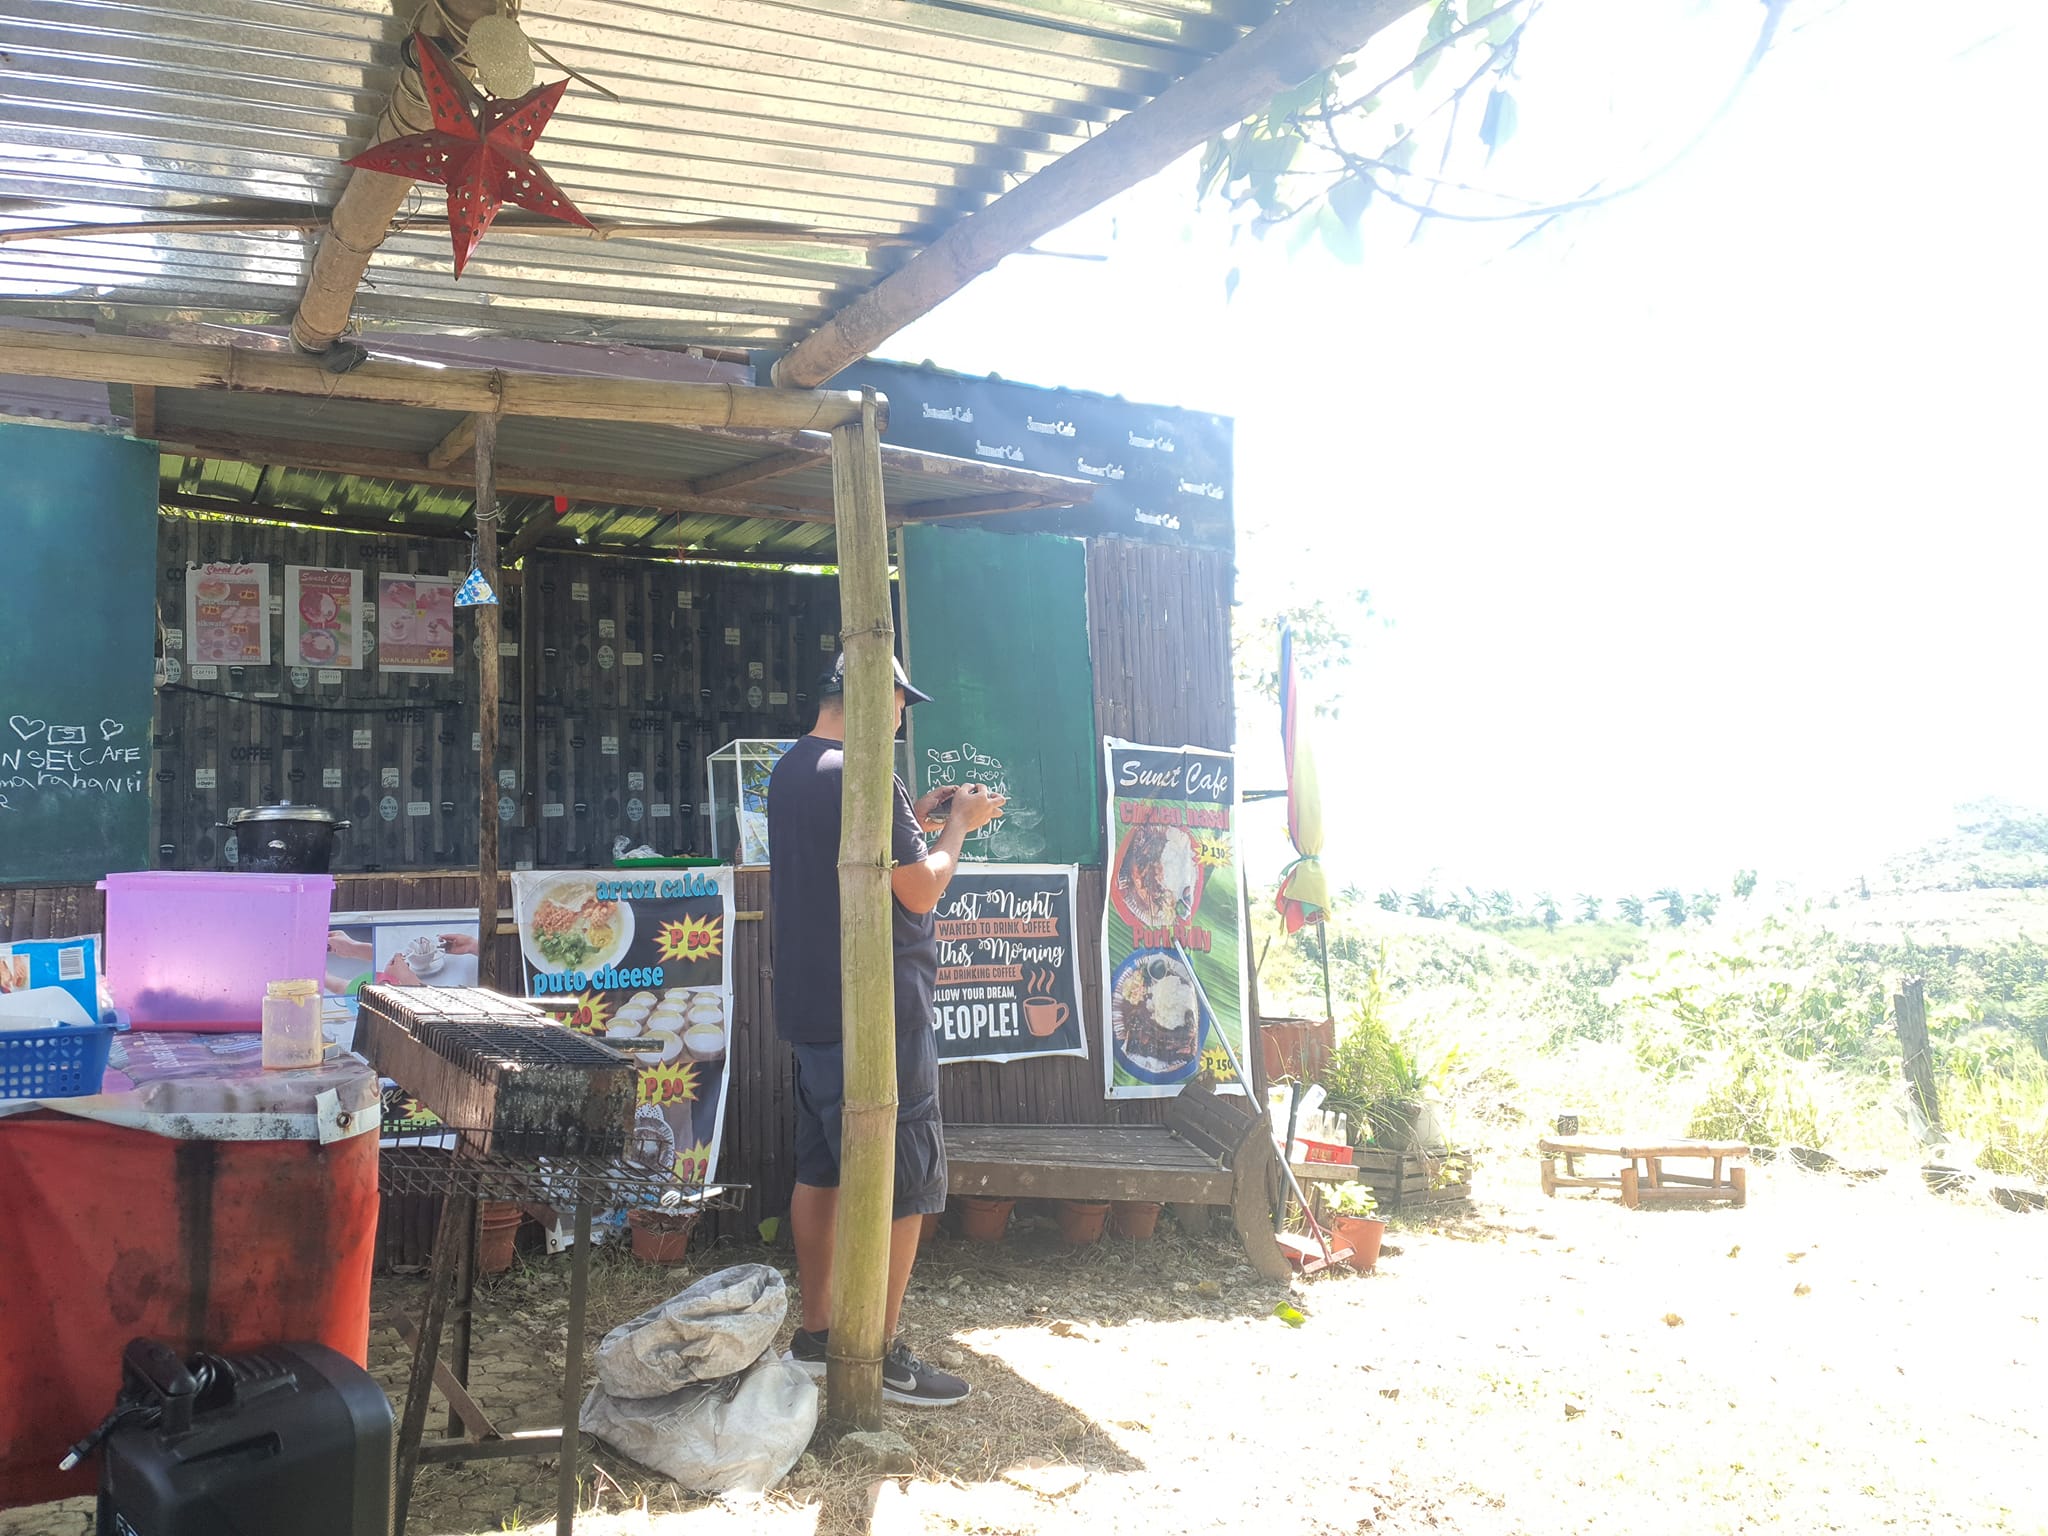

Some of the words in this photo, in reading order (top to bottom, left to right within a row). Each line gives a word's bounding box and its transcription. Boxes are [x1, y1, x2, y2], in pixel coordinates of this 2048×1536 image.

[230, 746, 273, 761] COFFEE
[1186, 762, 1228, 799] Cafe
[1201, 844, 1208, 857] P
[1211, 846, 1225, 860] 130
[596, 878, 657, 900] arroz
[661, 873, 719, 898] caldo
[933, 891, 982, 921] Last
[986, 889, 1063, 924] Night
[670, 928, 684, 949] P
[687, 930, 712, 952] 50
[939, 922, 977, 936] WANTED
[980, 922, 991, 935] TO
[993, 921, 1020, 934] DRINK
[1022, 920, 1051, 934] COFFEE
[1132, 925, 1171, 949] Pork
[936, 938, 974, 967] This
[979, 938, 1066, 968] Morning
[533, 968, 587, 998] puto
[592, 963, 664, 990] cheese
[938, 970, 951, 981] AM
[953, 968, 991, 981] DRINKING
[992, 967, 1017, 979] COFFEE
[962, 987, 985, 1000] YOUR
[986, 986, 1017, 1000] DREAM,
[932, 1002, 1020, 1040] PEOPLE!
[1206, 1057, 1213, 1069] P
[645, 1077, 658, 1099] P
[662, 1078, 684, 1101] 30
